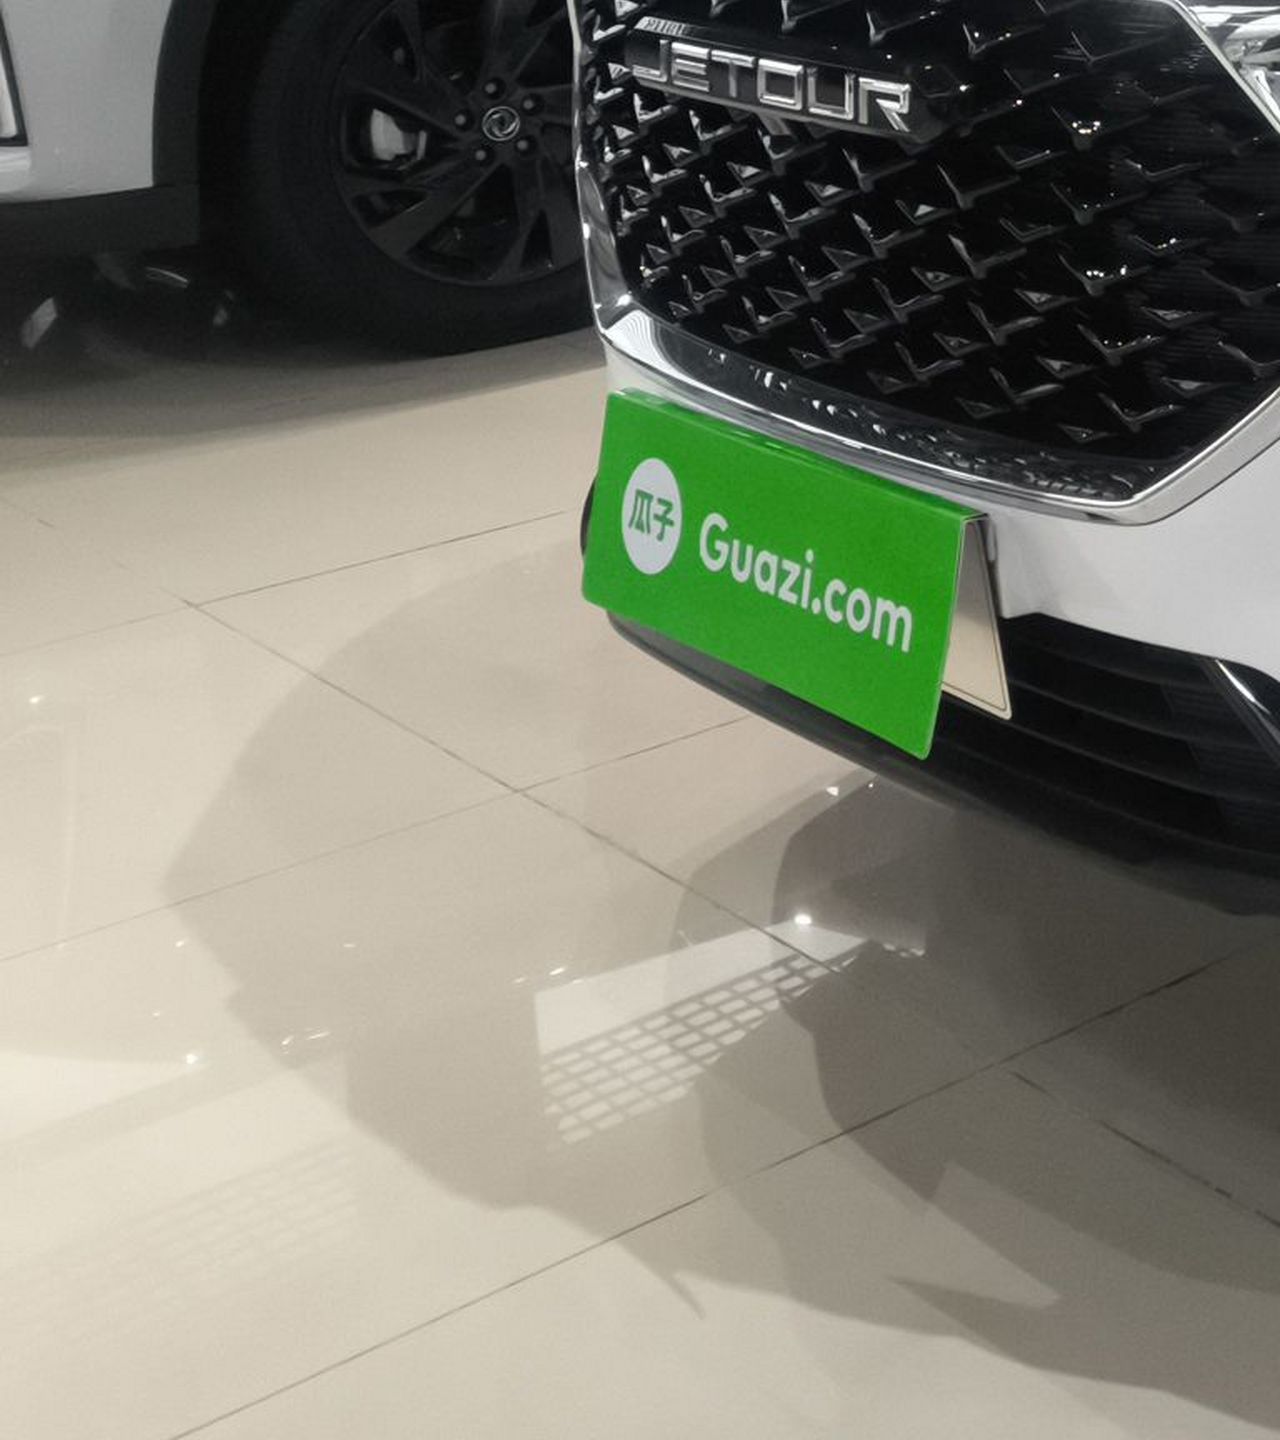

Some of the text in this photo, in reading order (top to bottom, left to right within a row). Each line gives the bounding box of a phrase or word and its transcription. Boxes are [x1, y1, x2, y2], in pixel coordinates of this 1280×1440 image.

[632, 38, 913, 132] JETOUR
[628, 488, 913, 653] 瓜子 Guazi.com
